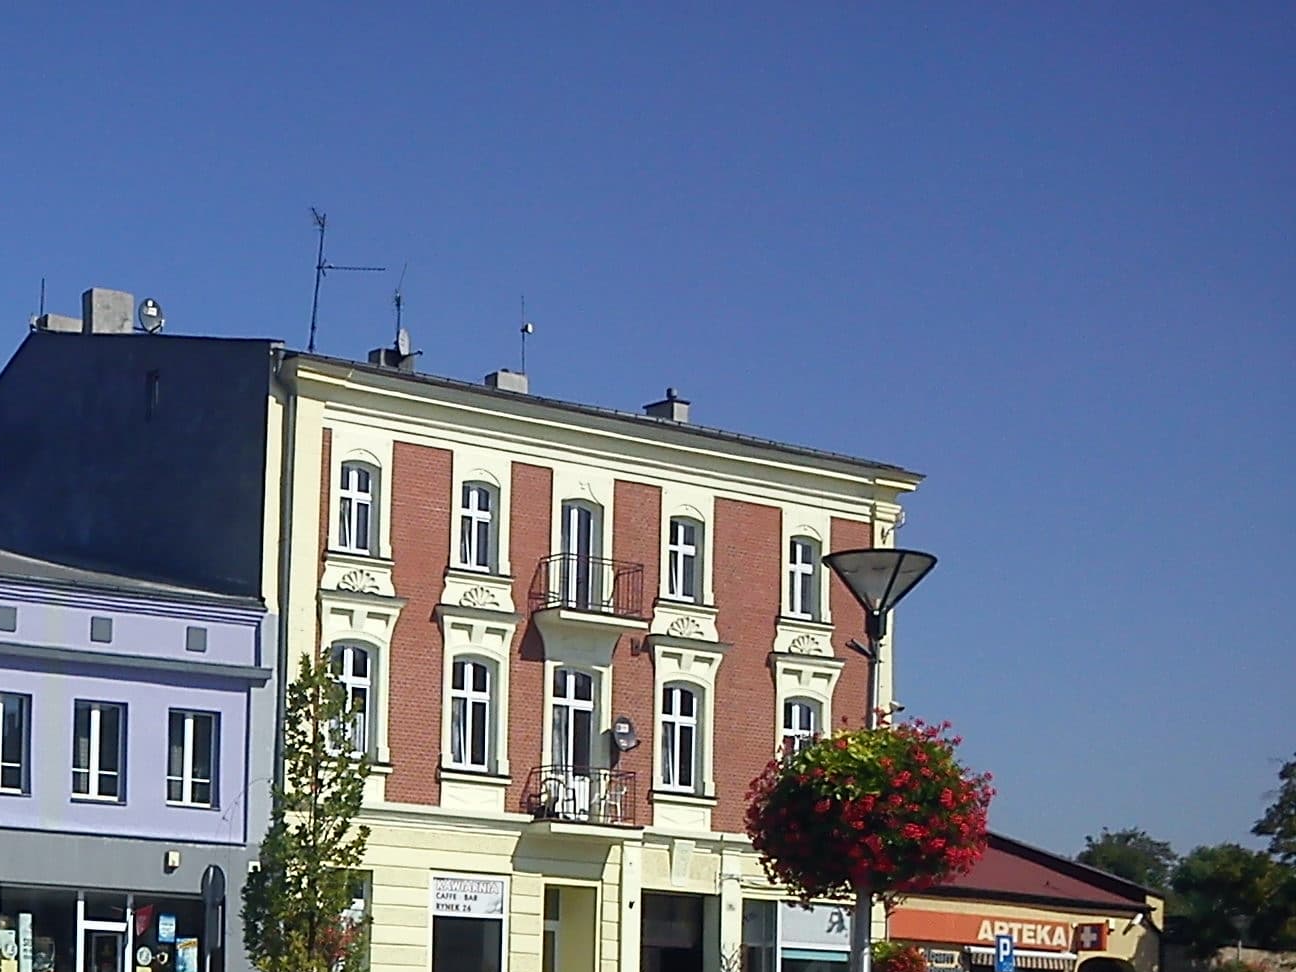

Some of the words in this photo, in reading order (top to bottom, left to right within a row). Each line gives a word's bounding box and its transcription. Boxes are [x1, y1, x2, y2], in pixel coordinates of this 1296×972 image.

[436, 879, 498, 894] KAWIARNIA
[436, 892, 456, 900] CAFFE
[436, 902, 459, 911] RYNEK
[977, 920, 1067, 946] APTEKA
[999, 938, 1010, 962] P
